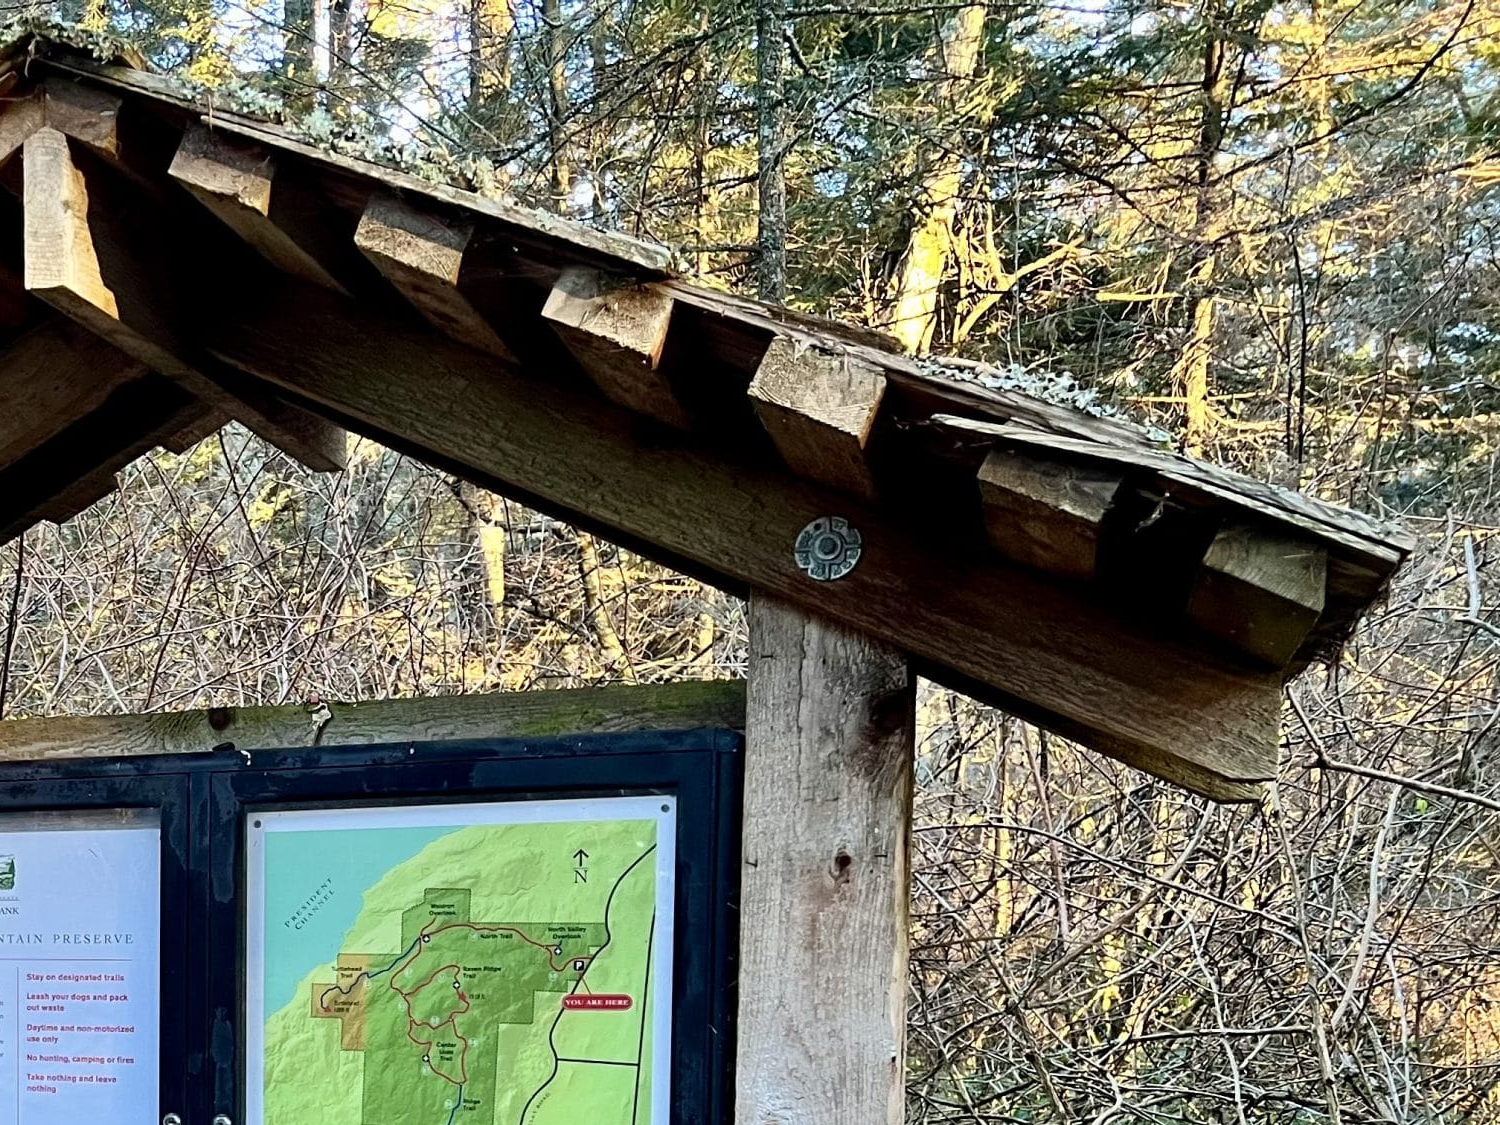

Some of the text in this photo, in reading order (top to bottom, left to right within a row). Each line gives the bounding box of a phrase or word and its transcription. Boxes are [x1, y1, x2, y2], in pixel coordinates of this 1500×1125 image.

[285, 878, 332, 928] PRESIDENT
[295, 890, 335, 929] CHANNEL
[53, 934, 134, 944] PRESERVE
[71, 993, 89, 1001] dogs
[26, 1024, 57, 1032] Daytime
[46, 1074, 76, 1082] nothing
